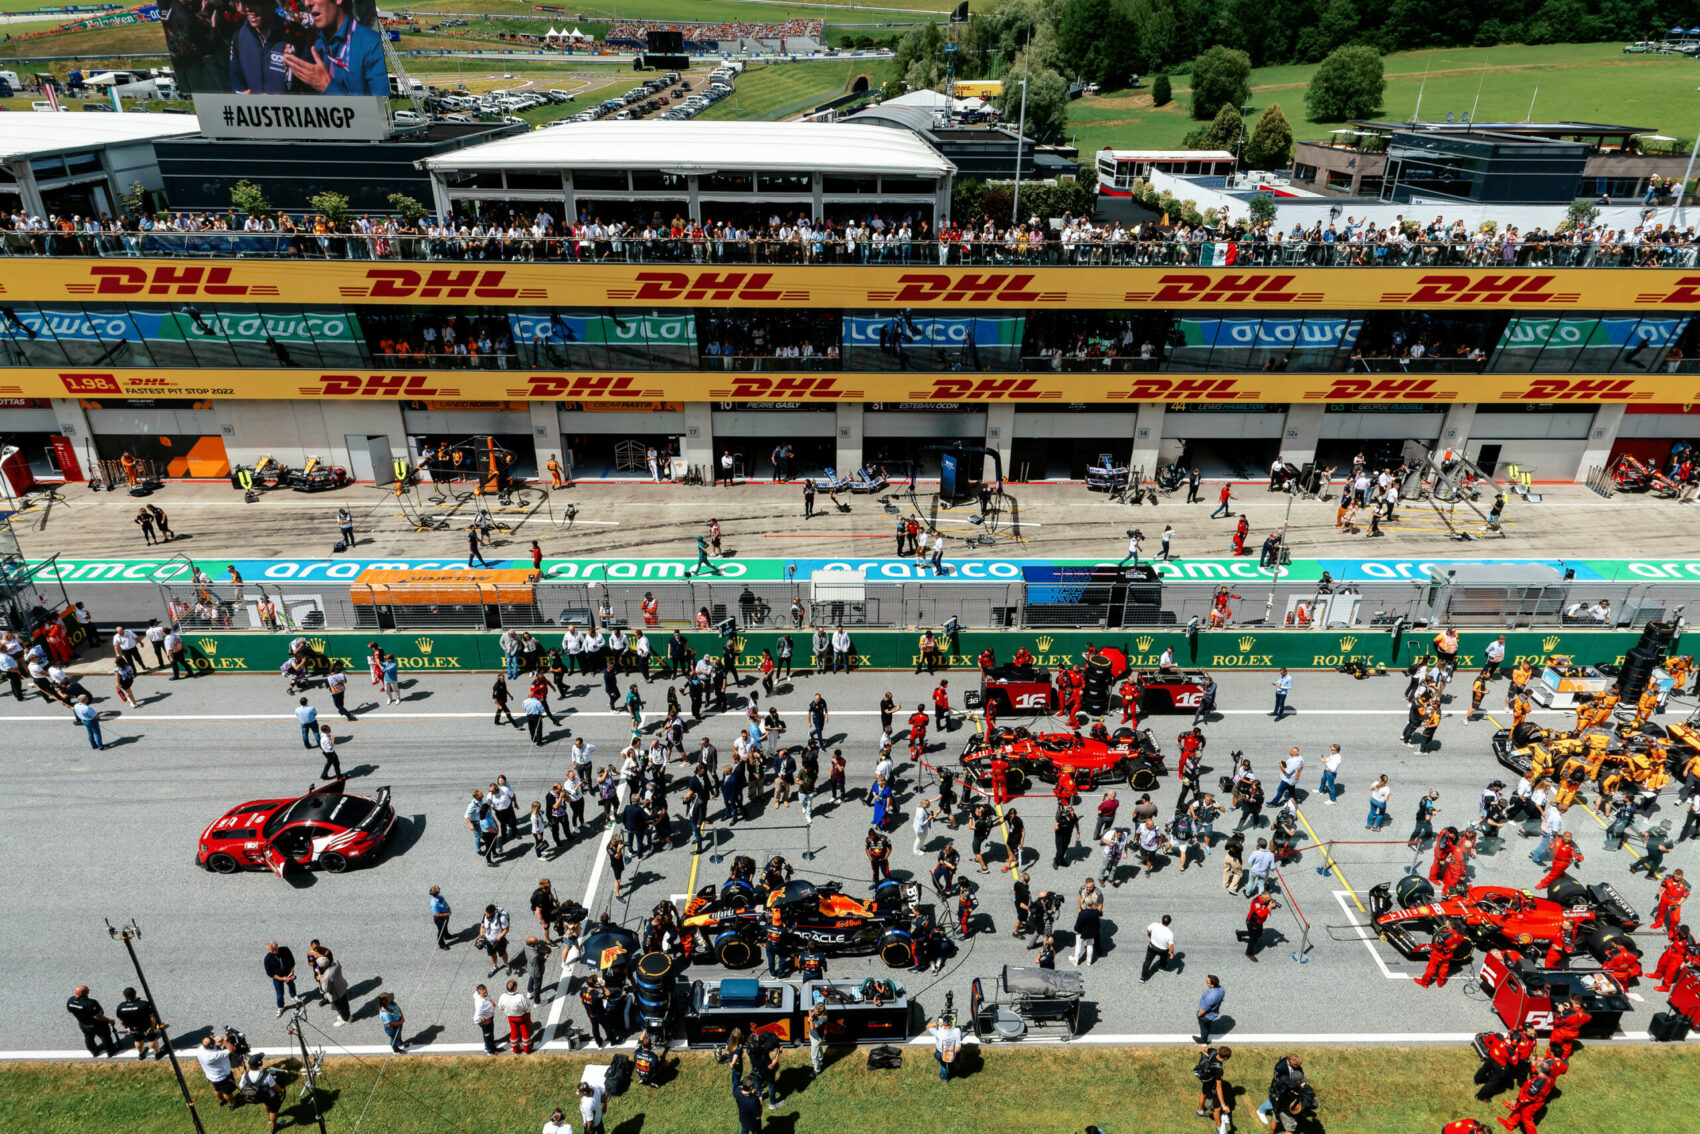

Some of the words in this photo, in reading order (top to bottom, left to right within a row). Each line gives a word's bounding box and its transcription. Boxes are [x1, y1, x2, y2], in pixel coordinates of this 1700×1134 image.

[223, 105, 355, 128] #AUSTRIANGP
[90, 266, 249, 295] DHL
[365, 269, 520, 298] DHL
[635, 271, 784, 300] DHL
[895, 273, 1041, 302] DHL
[1151, 275, 1299, 303] DHL
[1406, 276, 1555, 303] DHL
[127, 378, 170, 386] DHL
[320, 375, 439, 396] DHL
[528, 376, 643, 397] DHL
[730, 377, 844, 398] DHL
[930, 379, 1043, 399] DHL
[1128, 379, 1241, 399] DHL
[1323, 379, 1438, 399] DHL
[1520, 379, 1636, 399] DHL
[396, 656, 461, 668] ROLEX
[1212, 655, 1274, 666] ROLEX
[1015, 694, 1047, 710] 16
[1175, 692, 1205, 707] 16
